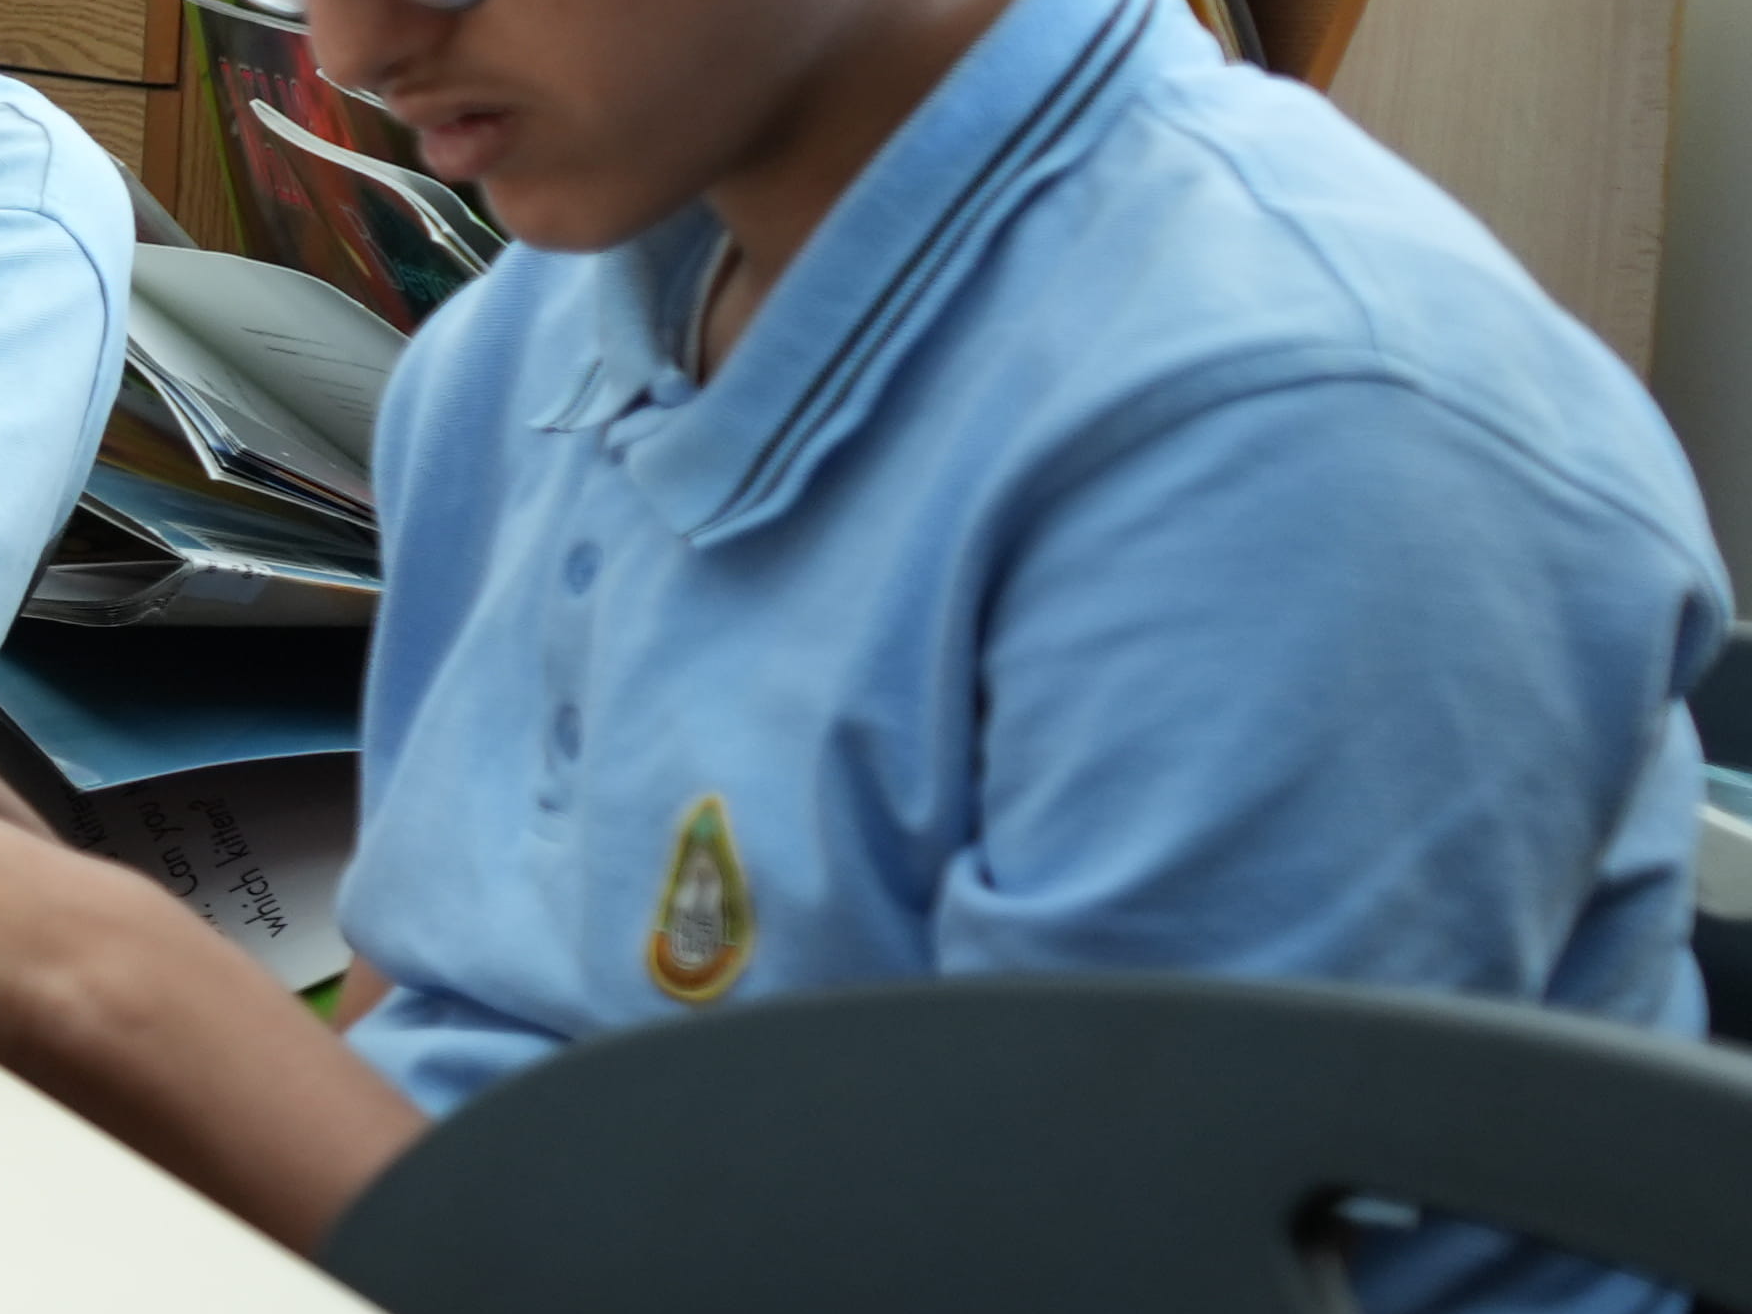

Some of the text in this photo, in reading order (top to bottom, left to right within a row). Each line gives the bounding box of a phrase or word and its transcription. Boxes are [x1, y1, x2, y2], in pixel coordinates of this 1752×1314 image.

[138, 800, 199, 899] Can you
[188, 797, 252, 869] kitten?
[228, 866, 289, 939] which
